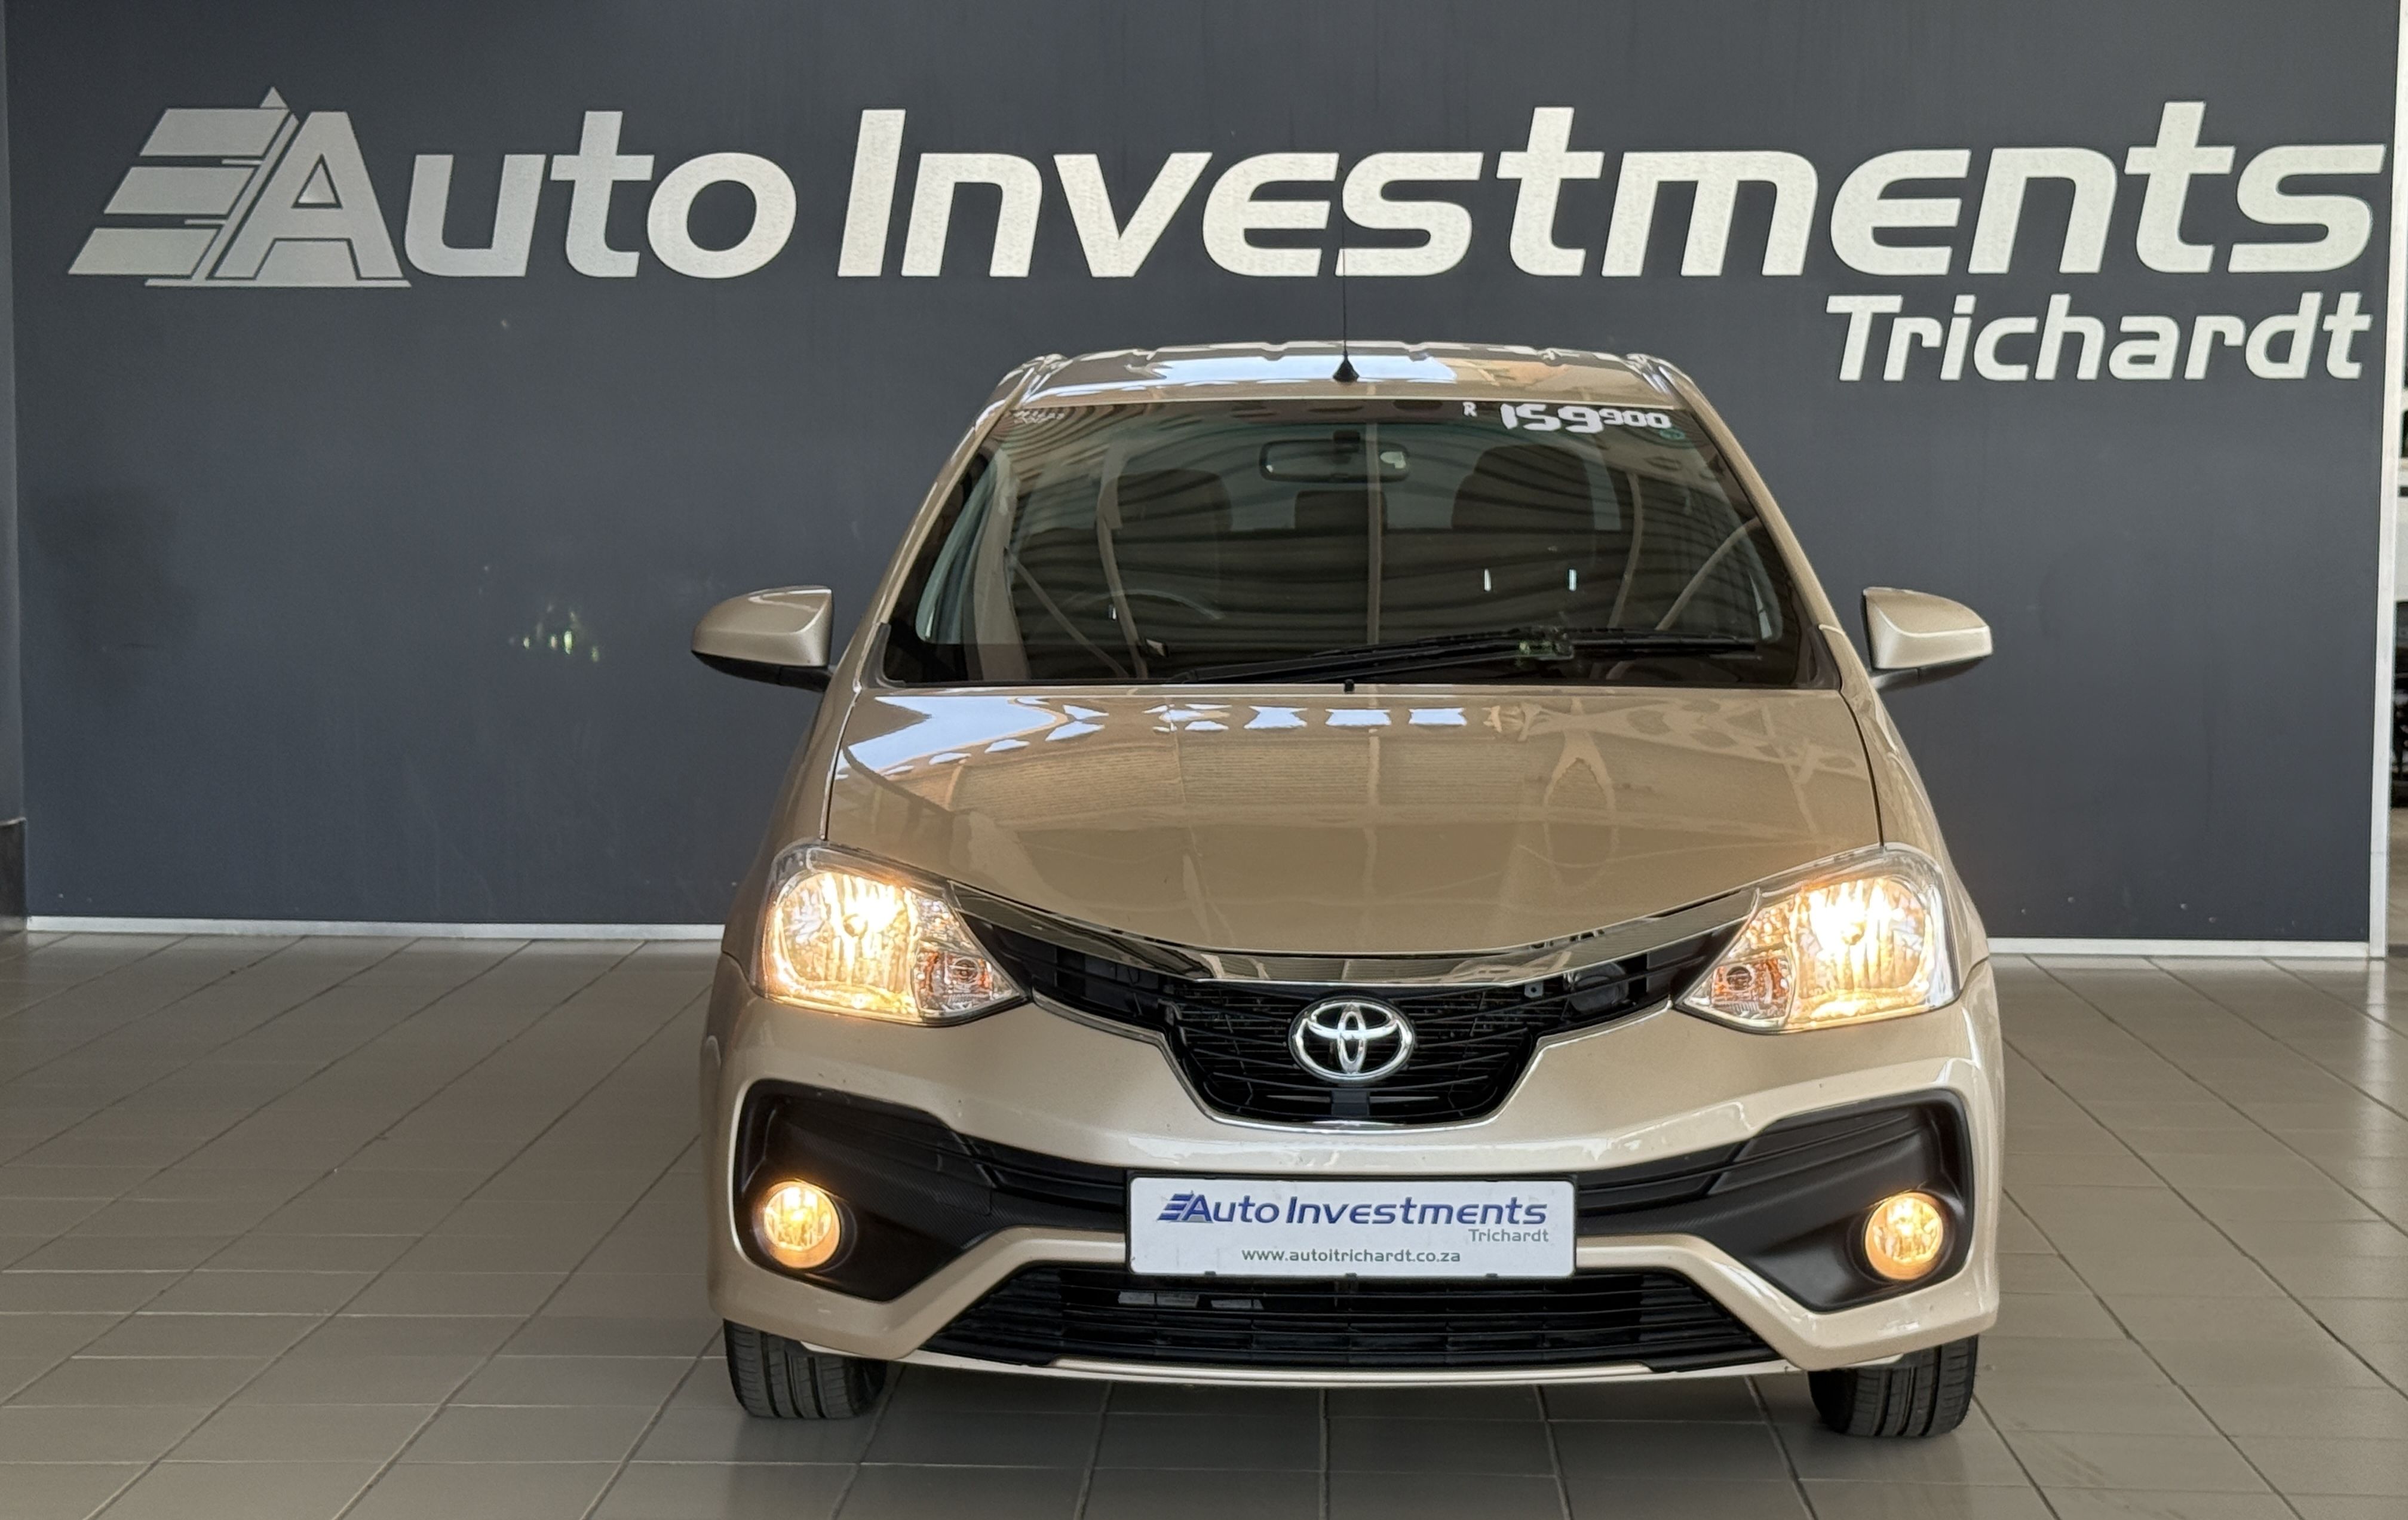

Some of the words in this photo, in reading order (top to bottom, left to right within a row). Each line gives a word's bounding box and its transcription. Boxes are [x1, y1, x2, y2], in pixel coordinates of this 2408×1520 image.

[203, 110, 797, 280] Auto
[838, 100, 2386, 278] Investments
[1826, 291, 2372, 382] Trichardt
[1462, 401, 1478, 417] R
[1181, 1194, 1279, 1224] Auto
[1286, 1196, 1548, 1225] Investments
[1468, 1228, 1549, 1243] Trichardt
[1241, 1248, 1461, 1263] www.autoitrichardt.co.za
